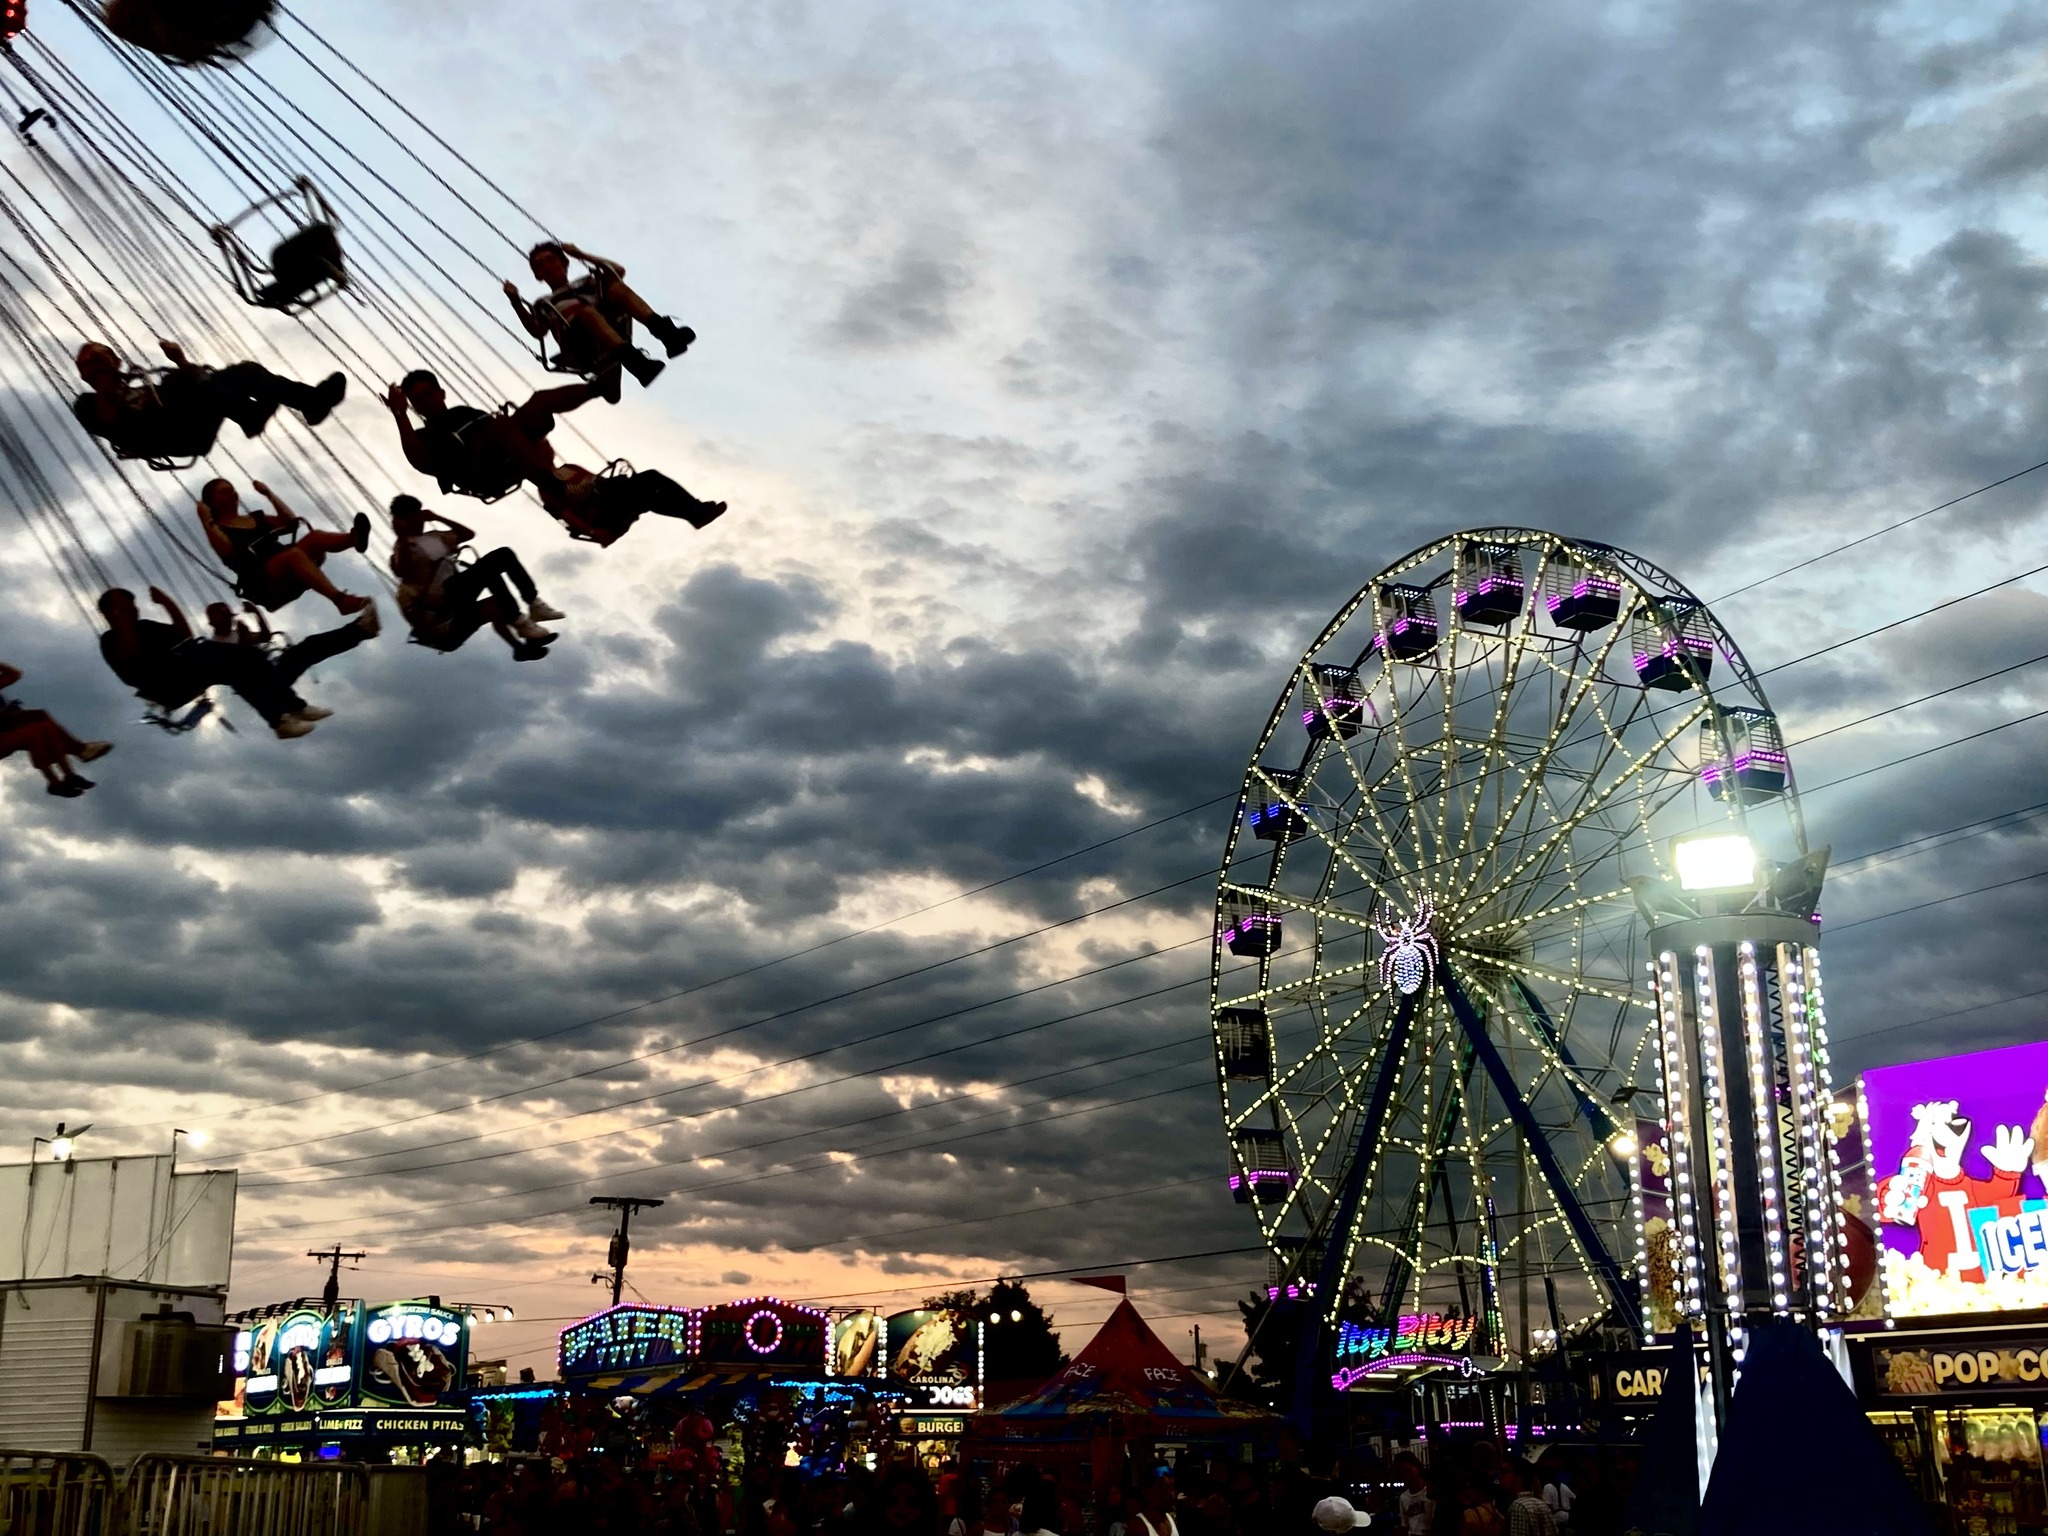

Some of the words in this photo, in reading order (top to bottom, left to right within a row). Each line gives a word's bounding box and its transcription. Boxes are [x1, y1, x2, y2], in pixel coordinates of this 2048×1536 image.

[1981, 1211, 2048, 1275] ICE
[368, 1315, 461, 1346] GYROS
[1143, 1367, 1182, 1382] FACE
[1932, 1352, 1999, 1384] POP
[909, 1375, 955, 1384] CAROLINA
[1616, 1368, 1669, 1397] CAR
[343, 1419, 363, 1430] FIZZ
[376, 1419, 429, 1430] CHICKEN
